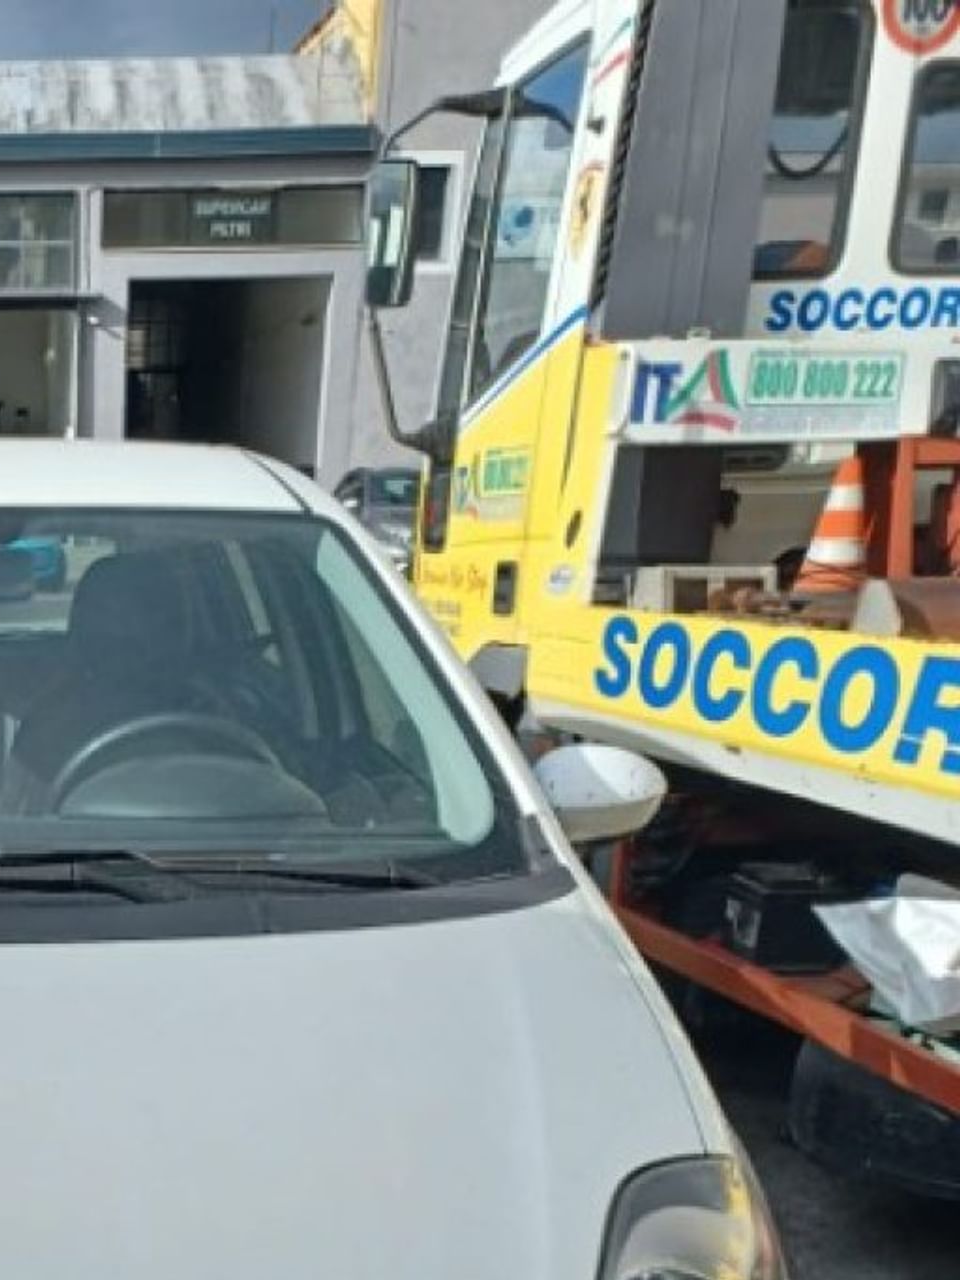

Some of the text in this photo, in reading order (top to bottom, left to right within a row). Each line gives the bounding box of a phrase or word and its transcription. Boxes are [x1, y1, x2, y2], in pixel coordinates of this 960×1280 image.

[764, 286, 960, 332] SOCCOR
[852, 359, 898, 398] 222
[593, 616, 960, 774] SOCCOR
